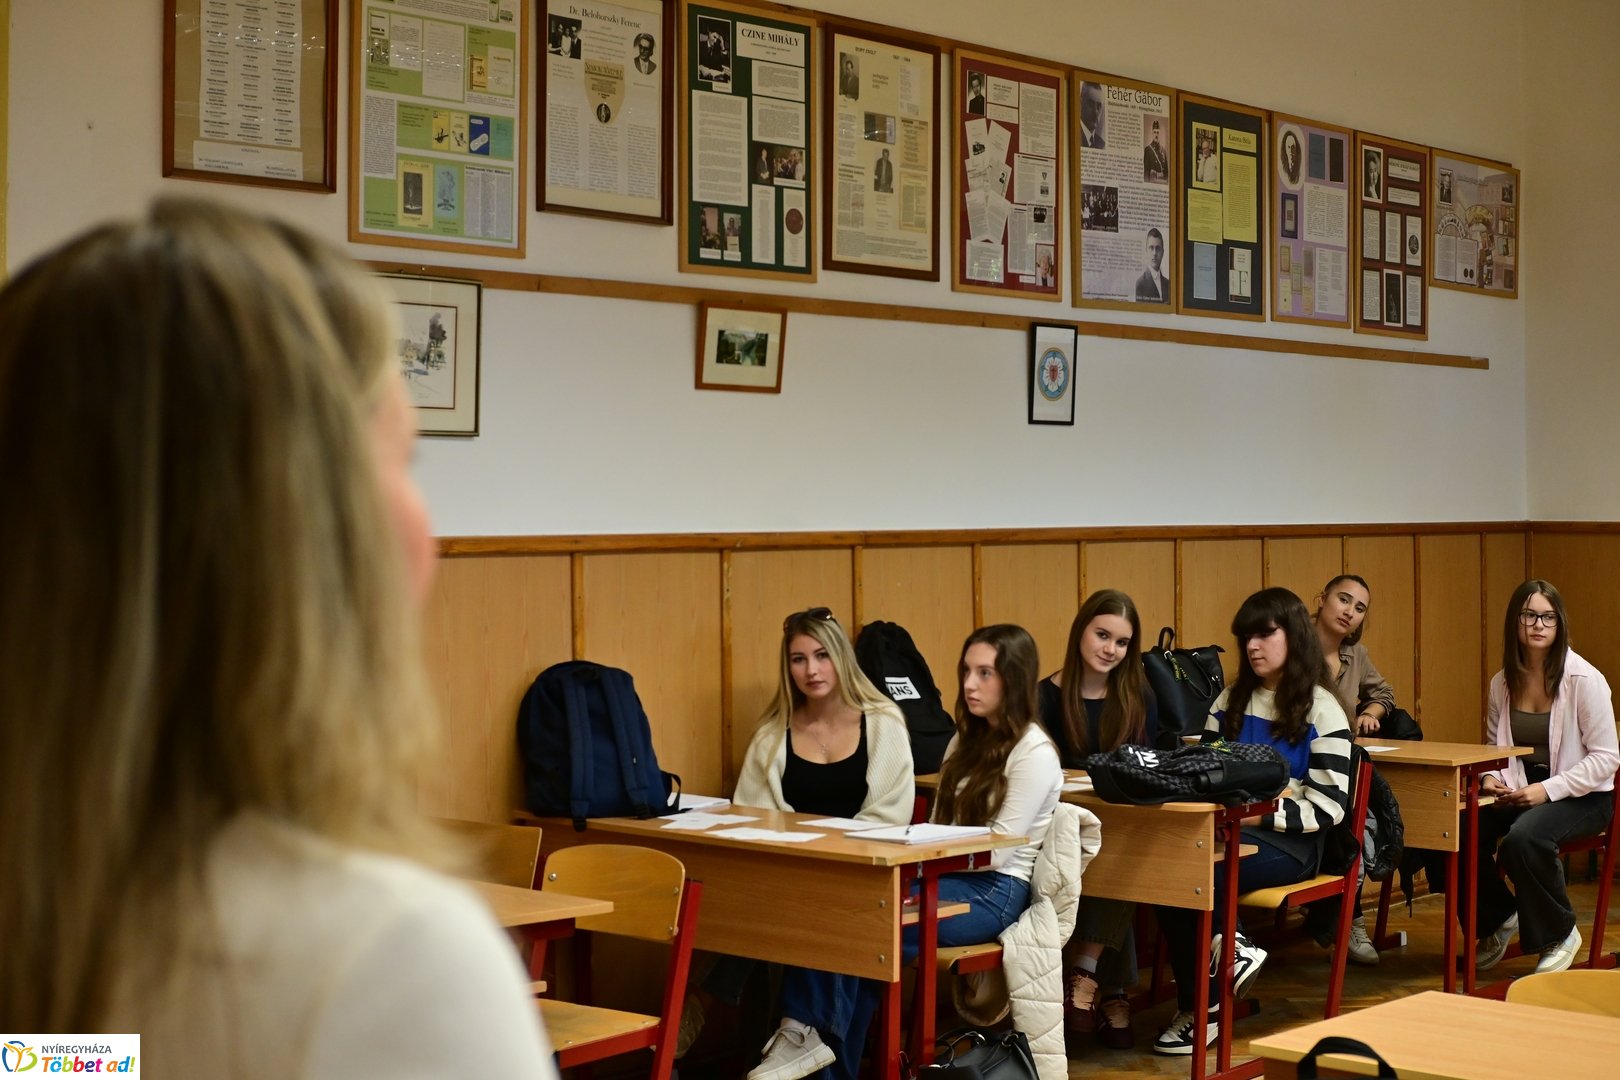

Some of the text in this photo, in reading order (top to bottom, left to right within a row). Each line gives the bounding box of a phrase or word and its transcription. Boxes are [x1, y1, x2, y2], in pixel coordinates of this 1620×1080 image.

[569, 5, 580, 16] Dr.
[621, 17, 641, 29] Ferenc
[741, 28, 800, 46] CZINE MIHÁLY
[1107, 85, 1162, 107] Fehér Gábor
[888, 683, 913, 696] ANS
